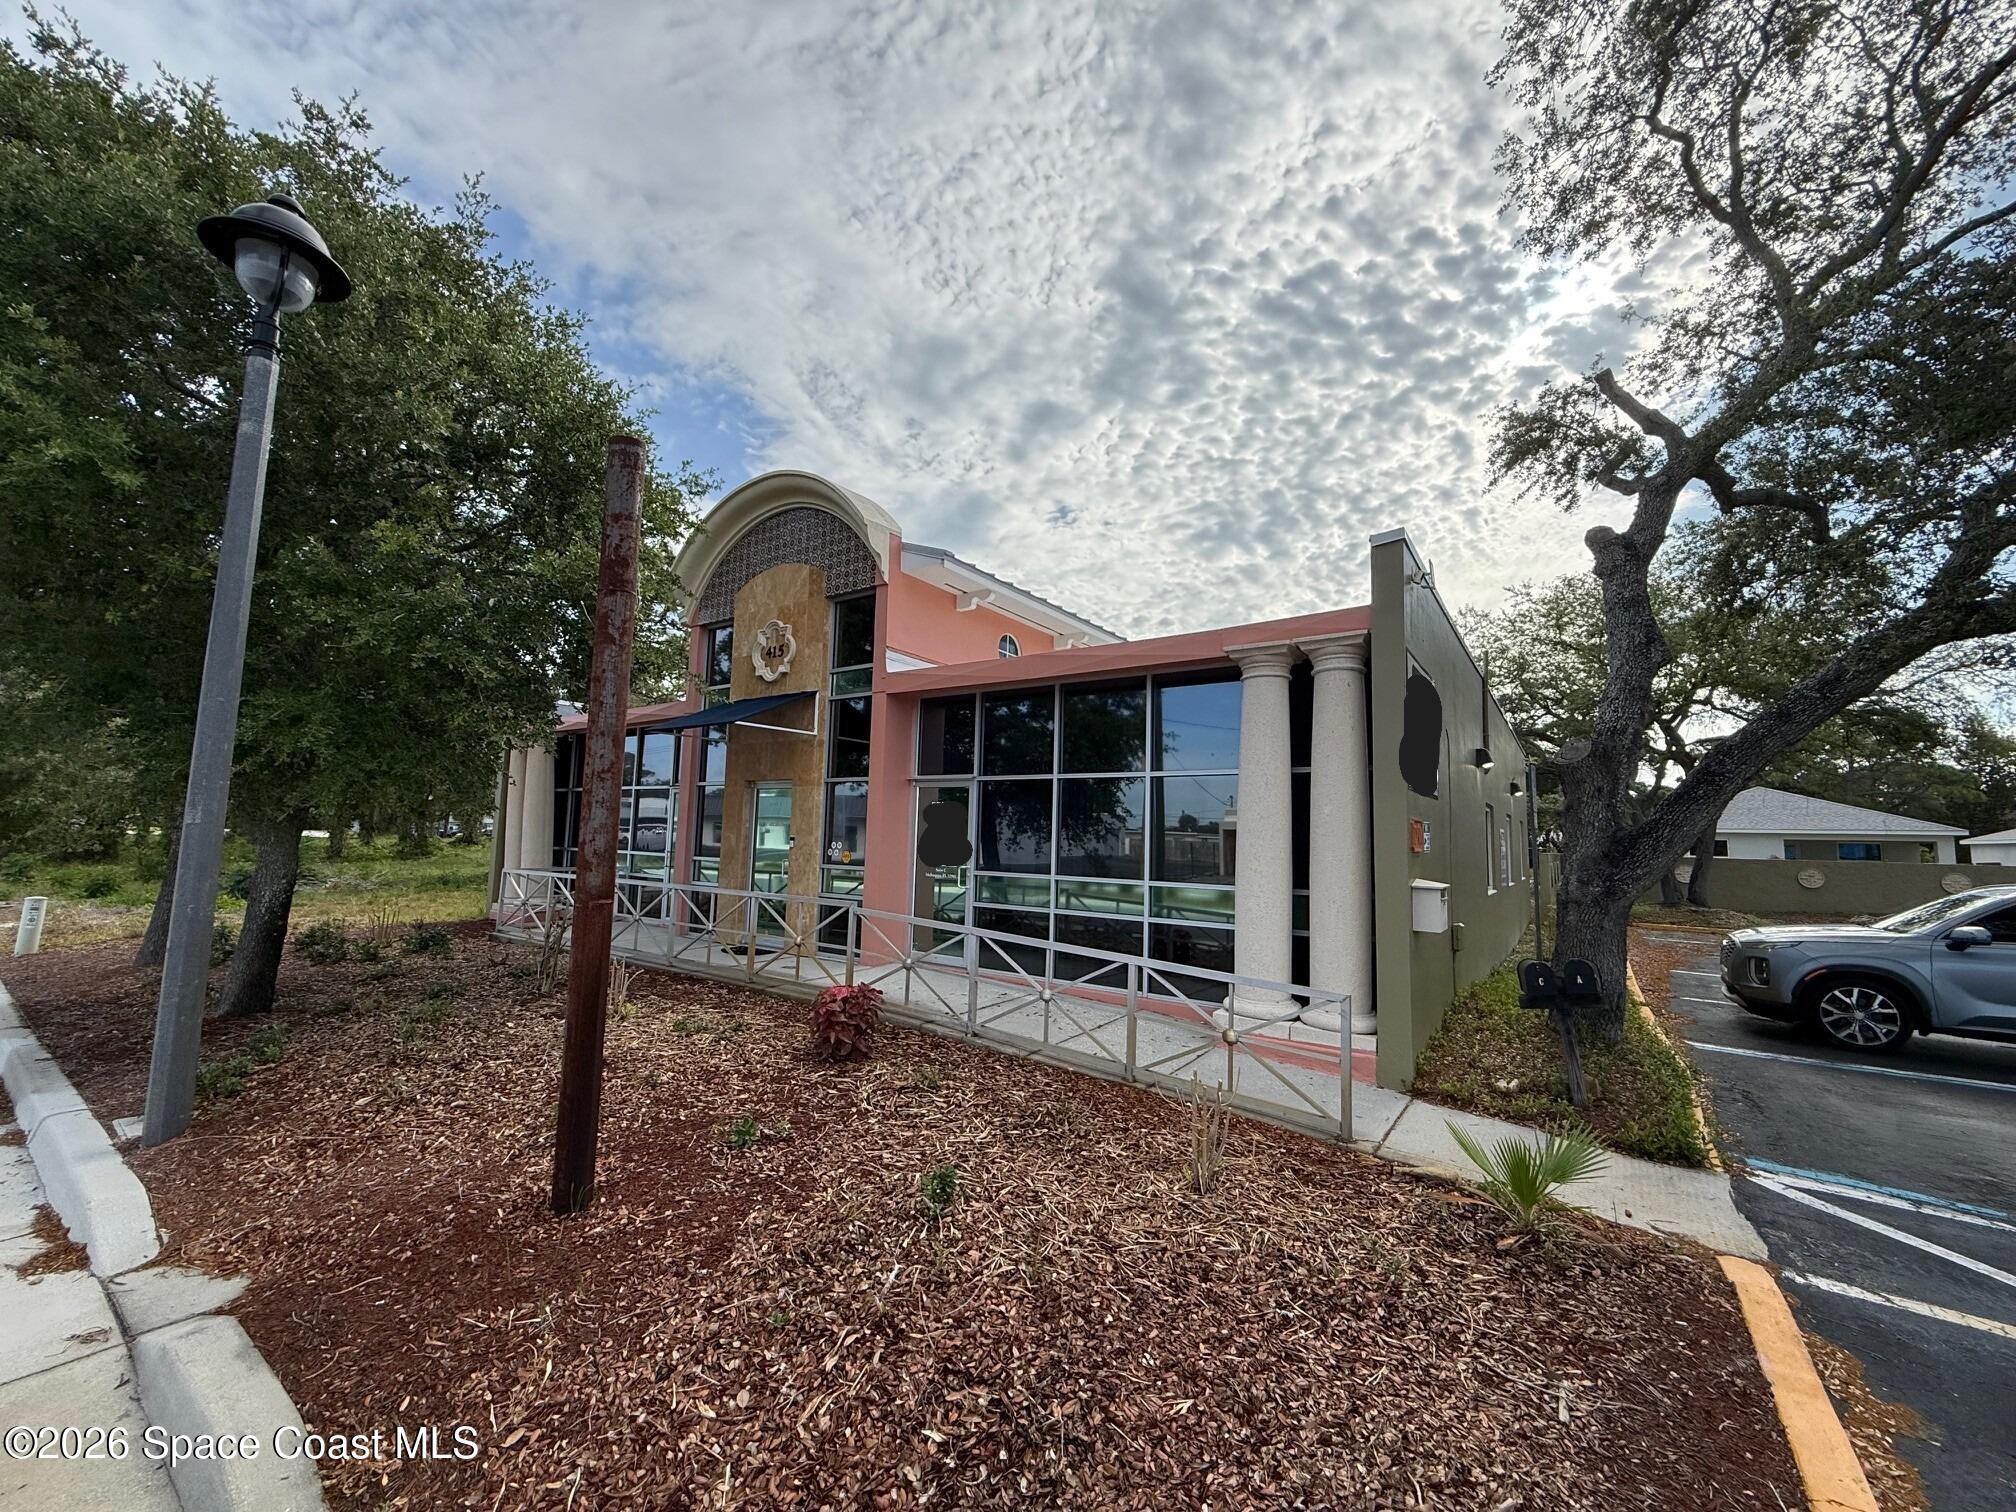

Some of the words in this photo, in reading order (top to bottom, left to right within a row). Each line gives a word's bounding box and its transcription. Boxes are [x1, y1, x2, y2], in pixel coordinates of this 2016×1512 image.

[765, 643, 785, 658] 415
[1538, 977, 1545, 986] C
[1576, 975, 1584, 984] A
